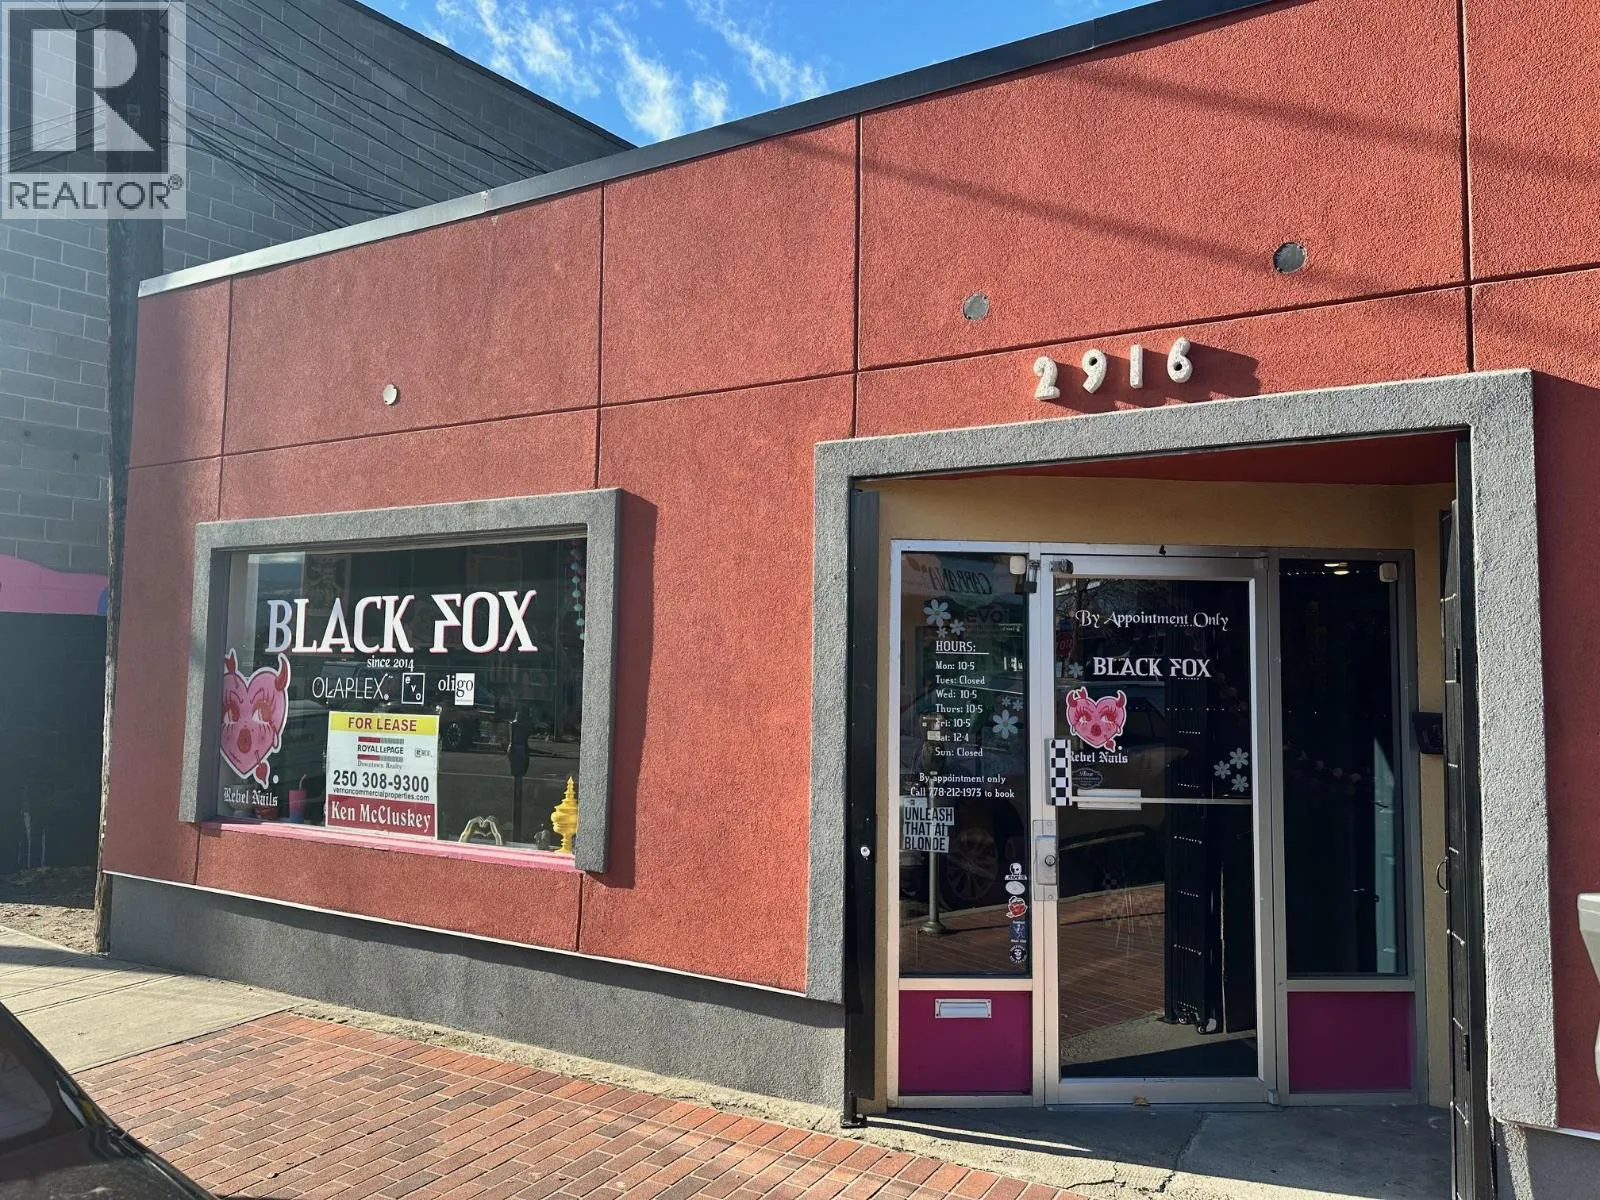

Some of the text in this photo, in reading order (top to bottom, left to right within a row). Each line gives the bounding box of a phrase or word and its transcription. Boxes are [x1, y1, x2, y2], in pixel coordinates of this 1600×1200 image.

[1033, 336, 1193, 401] 2916
[265, 590, 538, 654] BLACK FOX
[1075, 609, 1229, 632] By Appointment Only
[935, 640, 976, 652] HOURS:
[367, 657, 415, 672] since 2014
[935, 660, 955, 670] Mon:
[1093, 656, 1212, 678] BLACK FOX
[438, 674, 474, 698] oligo
[935, 675, 985, 685] Tues: Closed
[936, 689, 956, 699] Wed:
[935, 703, 963, 713] Thurs:
[348, 717, 418, 732] FOR LEASE
[935, 718, 951, 728] Fri:
[357, 744, 379, 753] ROYAL
[935, 747, 983, 757] Sun: Closed
[1098, 752, 1129, 764] Nails
[333, 769, 429, 793] 250 308-9300
[919, 772, 1007, 784] By appointment only
[223, 787, 279, 807] Rebel Nails
[333, 787, 430, 801] vernoncommercialproperties.com
[910, 786, 926, 797] Call
[984, 788, 993, 798] to
[995, 788, 1015, 798] book
[331, 801, 431, 833] Ken McCluskey
[904, 806, 953, 822] UNLEASH
[904, 821, 932, 836] THAT
[904, 836, 946, 851] BLONDE
